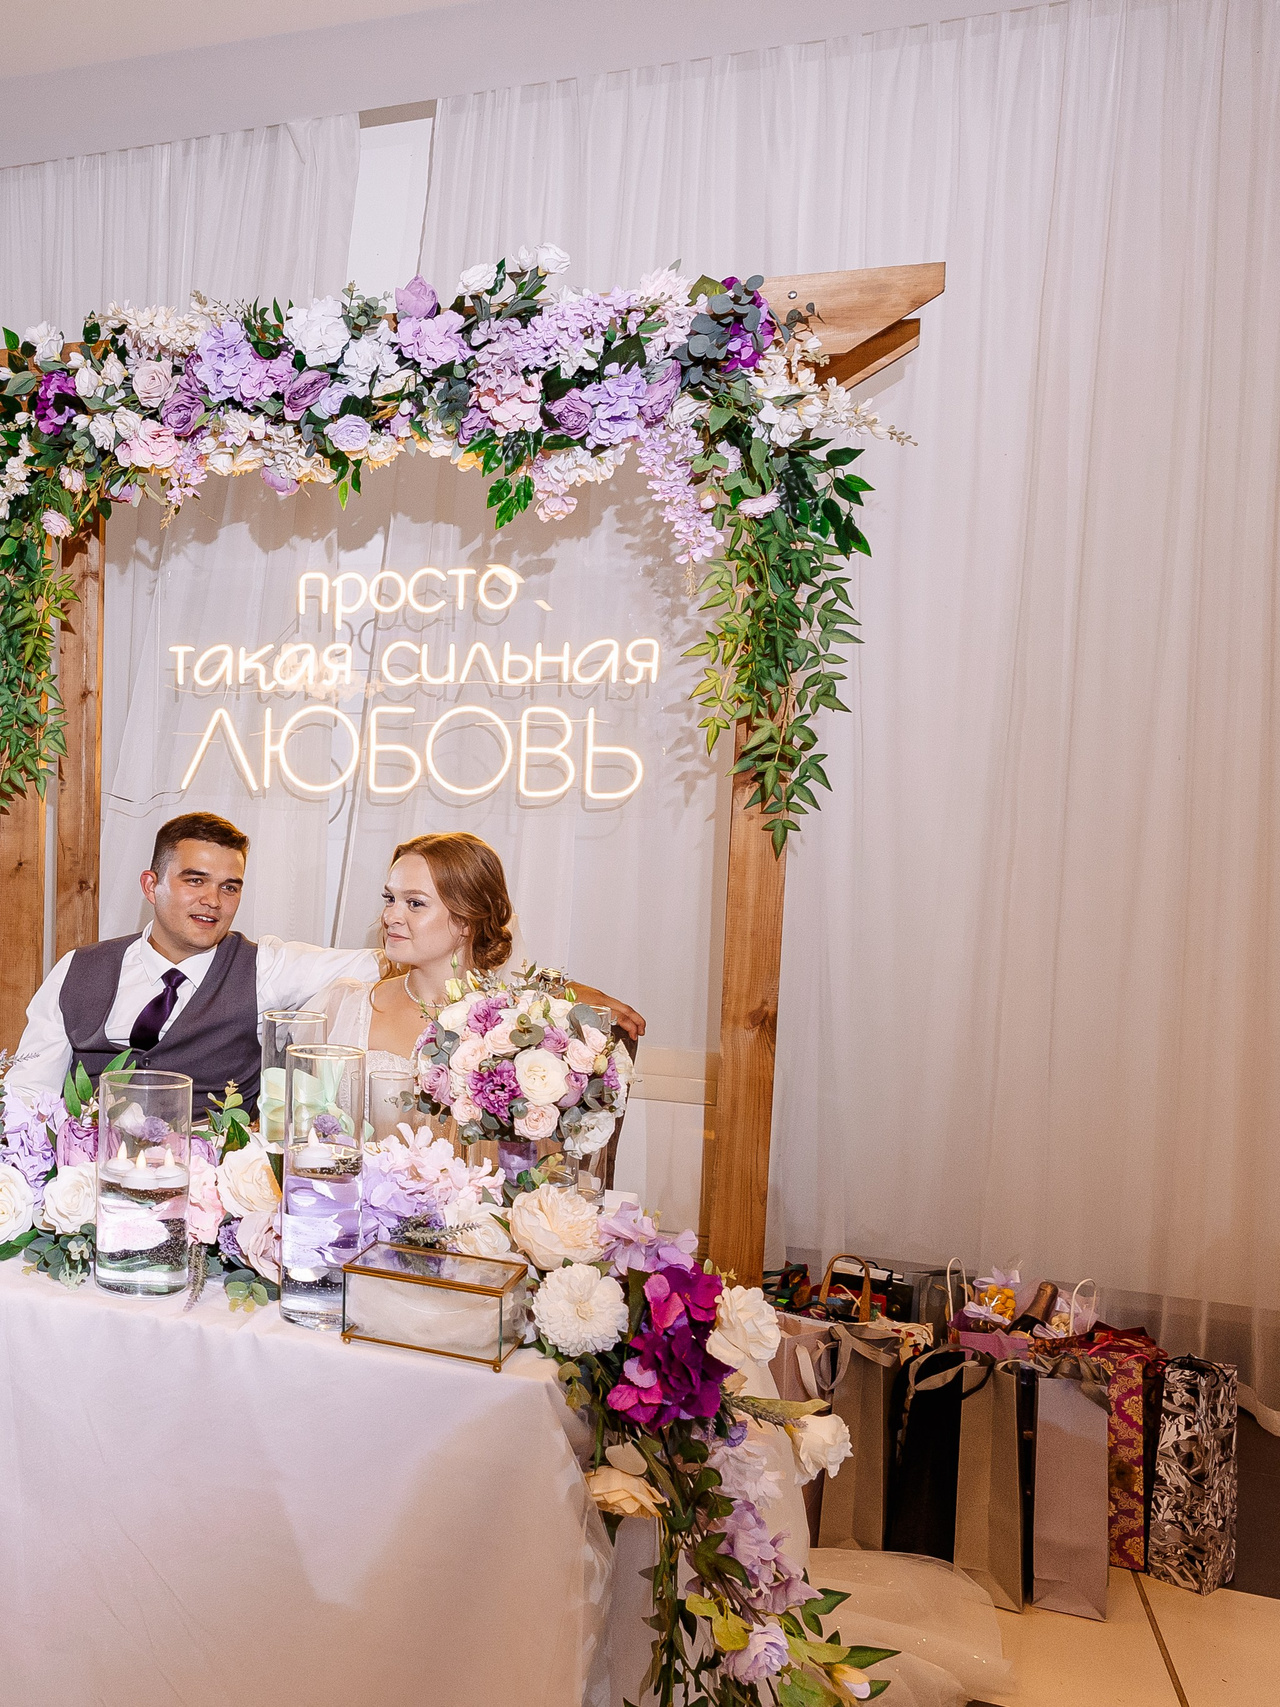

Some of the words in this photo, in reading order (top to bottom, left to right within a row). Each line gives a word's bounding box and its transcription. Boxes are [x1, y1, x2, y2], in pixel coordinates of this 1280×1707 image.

[298, 570, 518, 631] просто
[168, 642, 353, 691] такая
[381, 638, 660, 685] сильная
[181, 704, 644, 800] ЛЮБОВЬ
